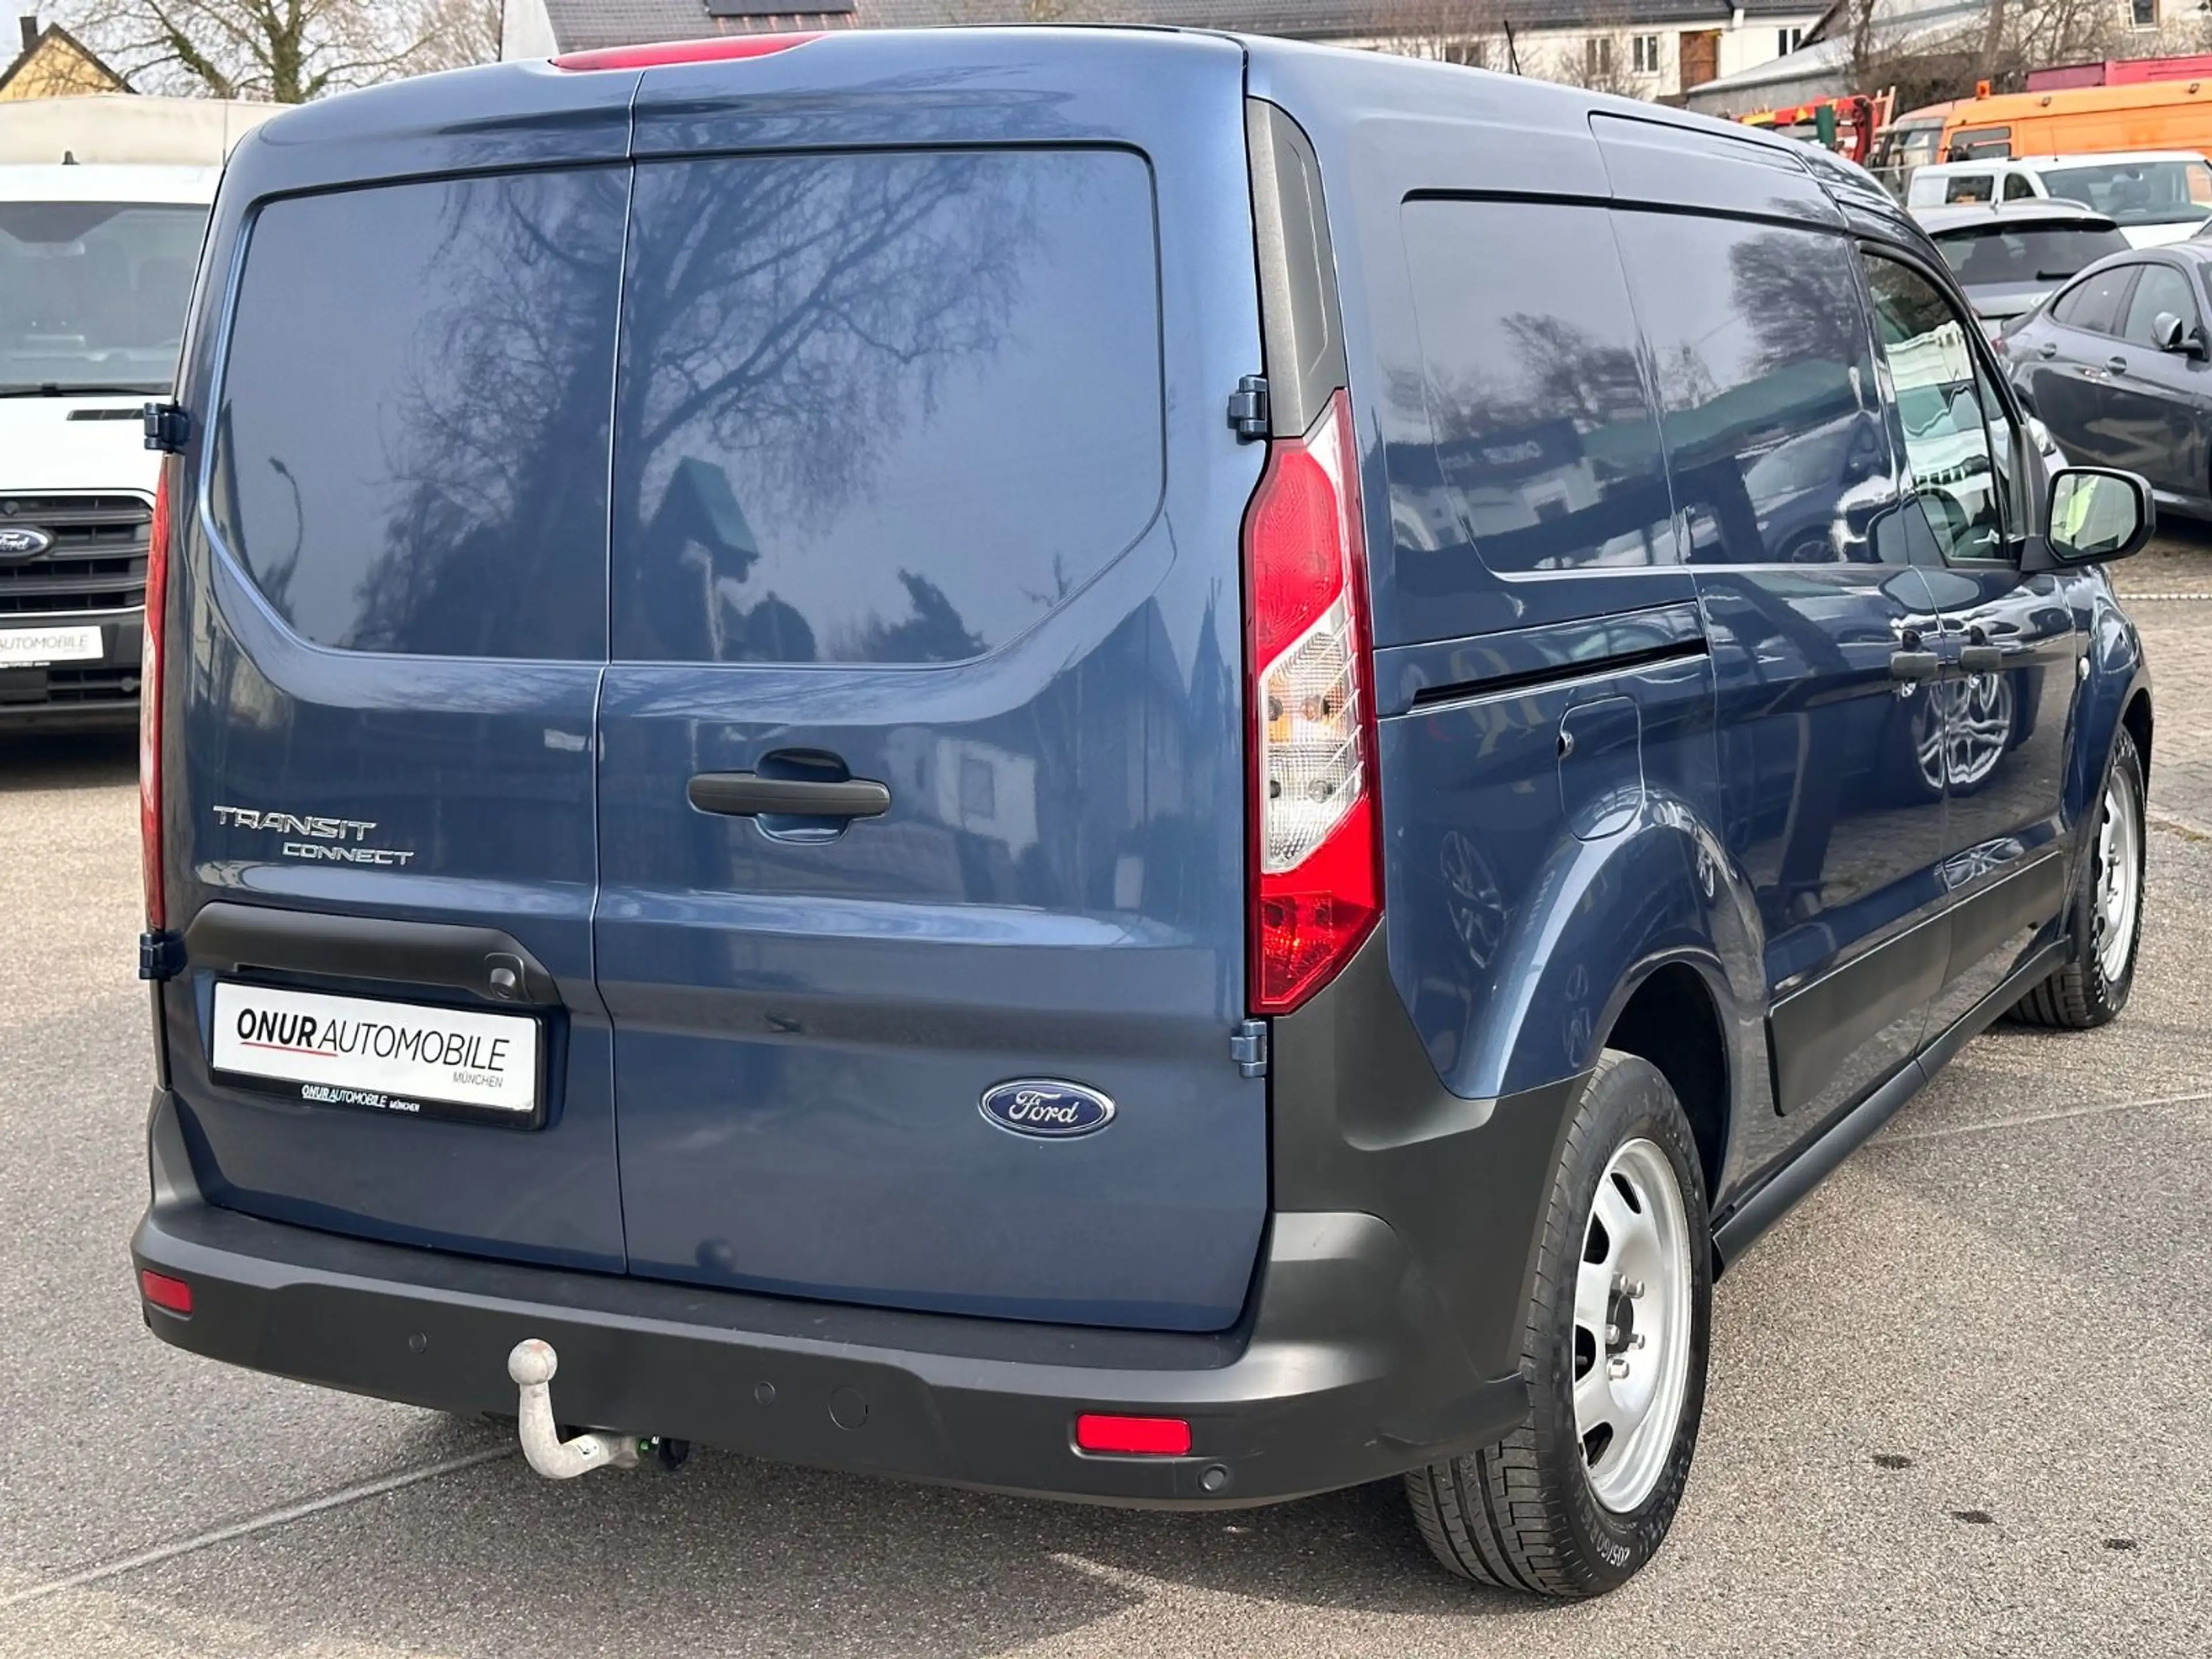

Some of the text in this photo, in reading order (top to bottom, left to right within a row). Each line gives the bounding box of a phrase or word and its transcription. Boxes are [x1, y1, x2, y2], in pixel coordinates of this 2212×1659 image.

[213, 805, 377, 841] TRANSIT
[282, 841, 415, 866] CONNECT
[453, 1070, 503, 1089] MÜNCHEN
[1009, 1090, 1079, 1124] Ford
